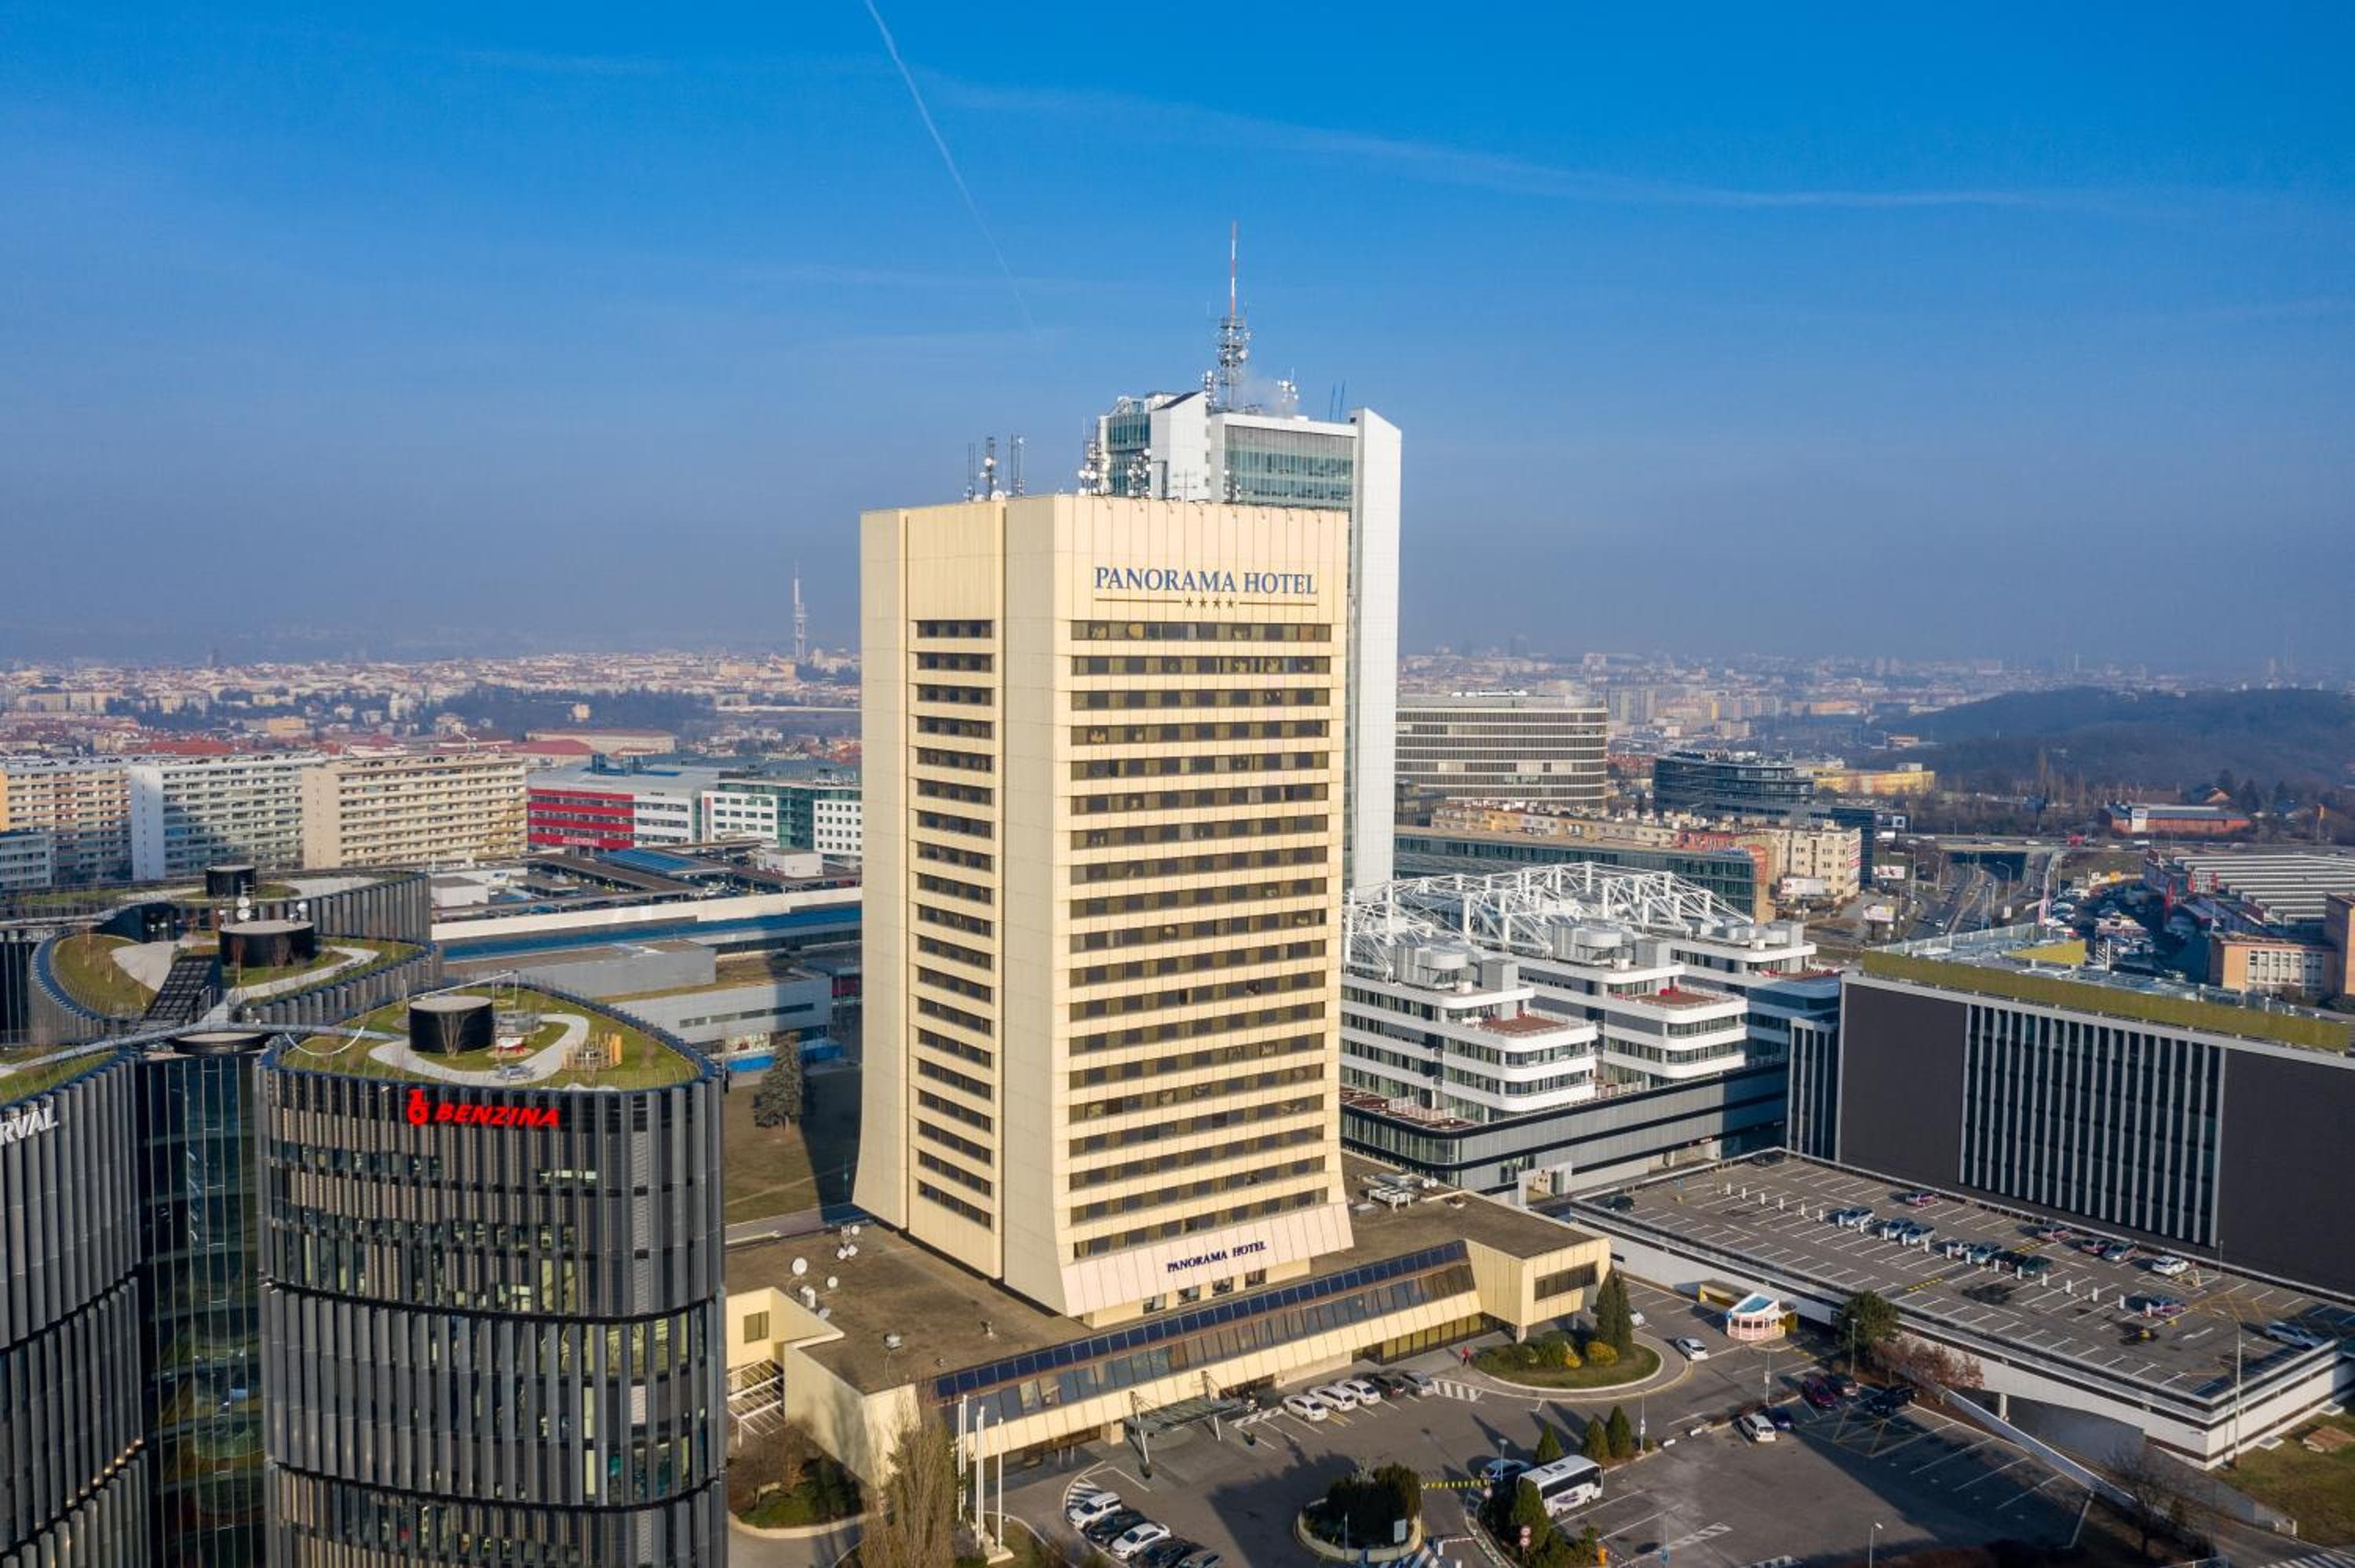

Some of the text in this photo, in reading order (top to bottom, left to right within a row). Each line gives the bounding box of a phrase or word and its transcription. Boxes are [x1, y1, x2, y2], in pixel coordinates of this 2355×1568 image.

[1094, 567, 1318, 595] PANORAMA HOTEL
[434, 1101, 561, 1128] BENZINA
[1167, 1241, 1267, 1273] PANORAMA HOTEL
